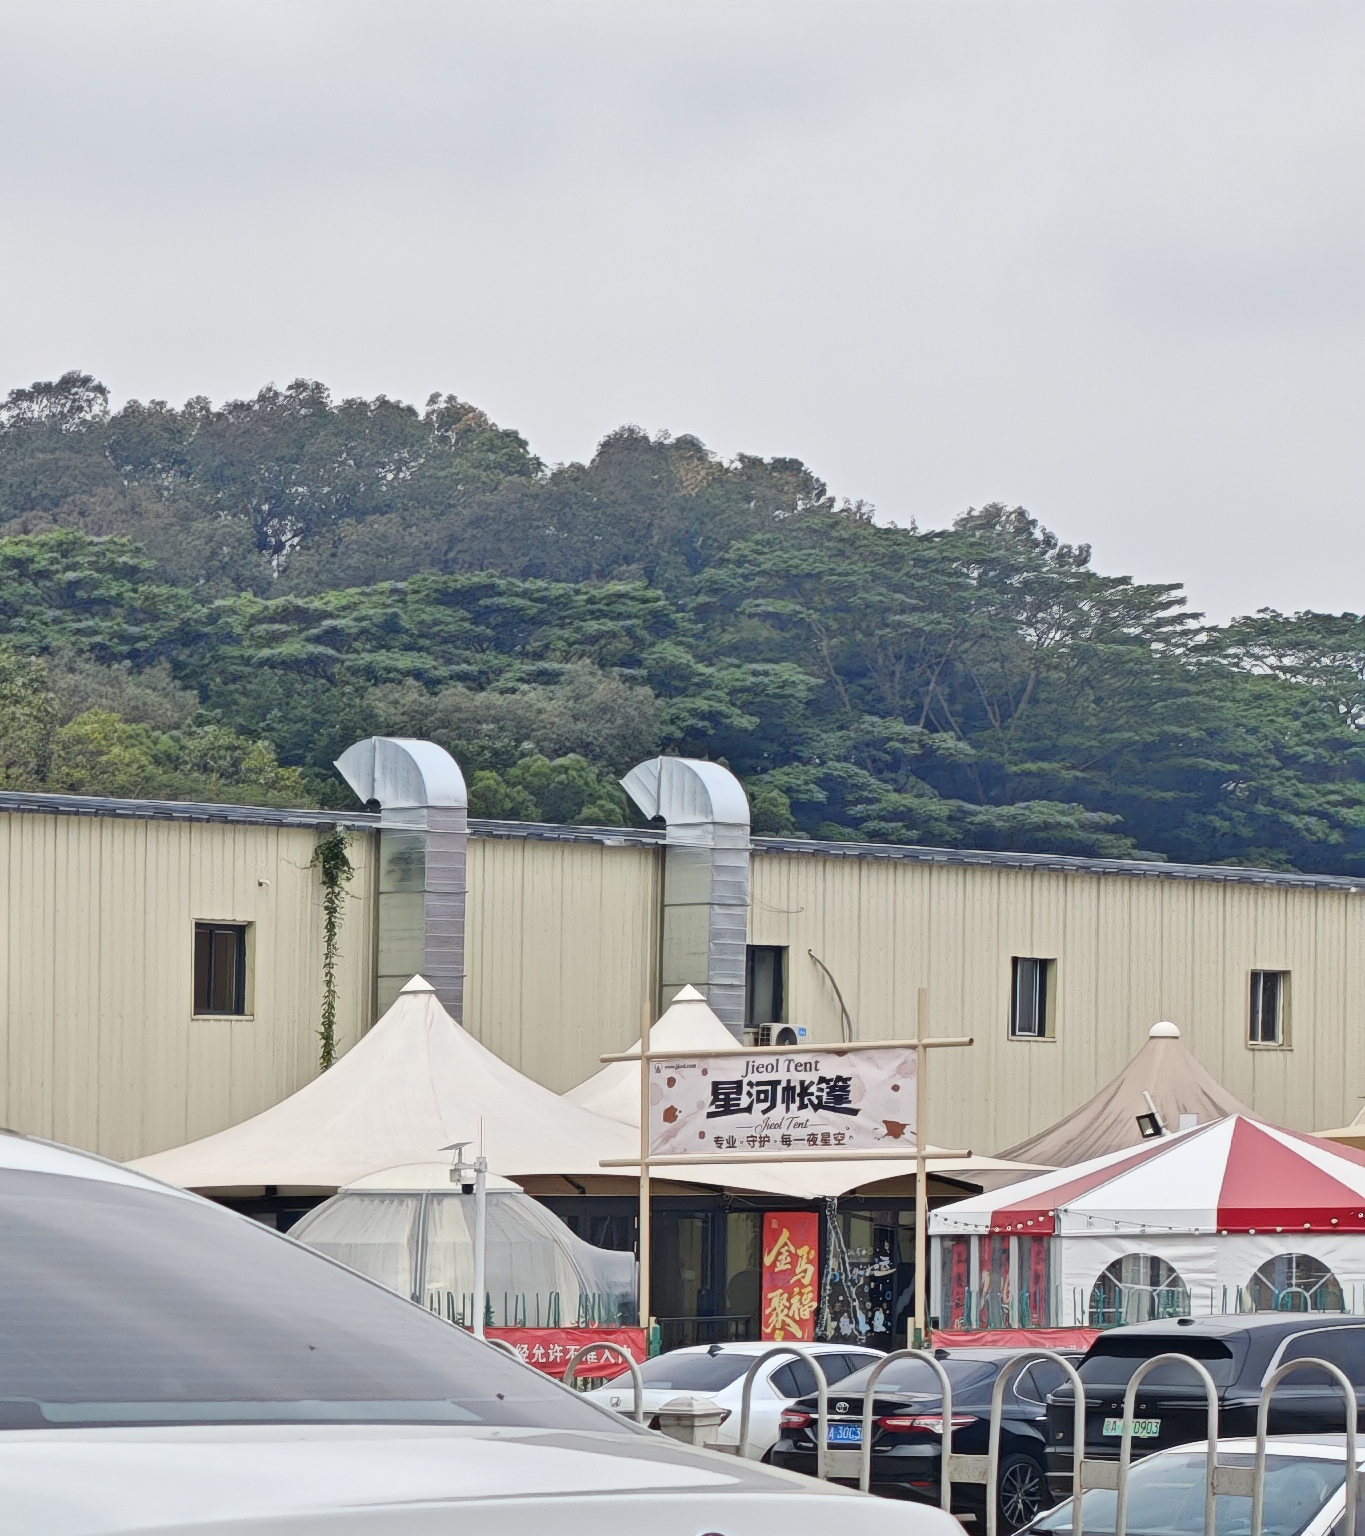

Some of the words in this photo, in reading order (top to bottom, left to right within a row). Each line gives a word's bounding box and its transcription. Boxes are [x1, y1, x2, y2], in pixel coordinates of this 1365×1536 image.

[741, 1058, 779, 1078] Jieol
[784, 1057, 820, 1073] Tent
[706, 1075, 862, 1119] 星河帐篷
[785, 1115, 810, 1131] Tent
